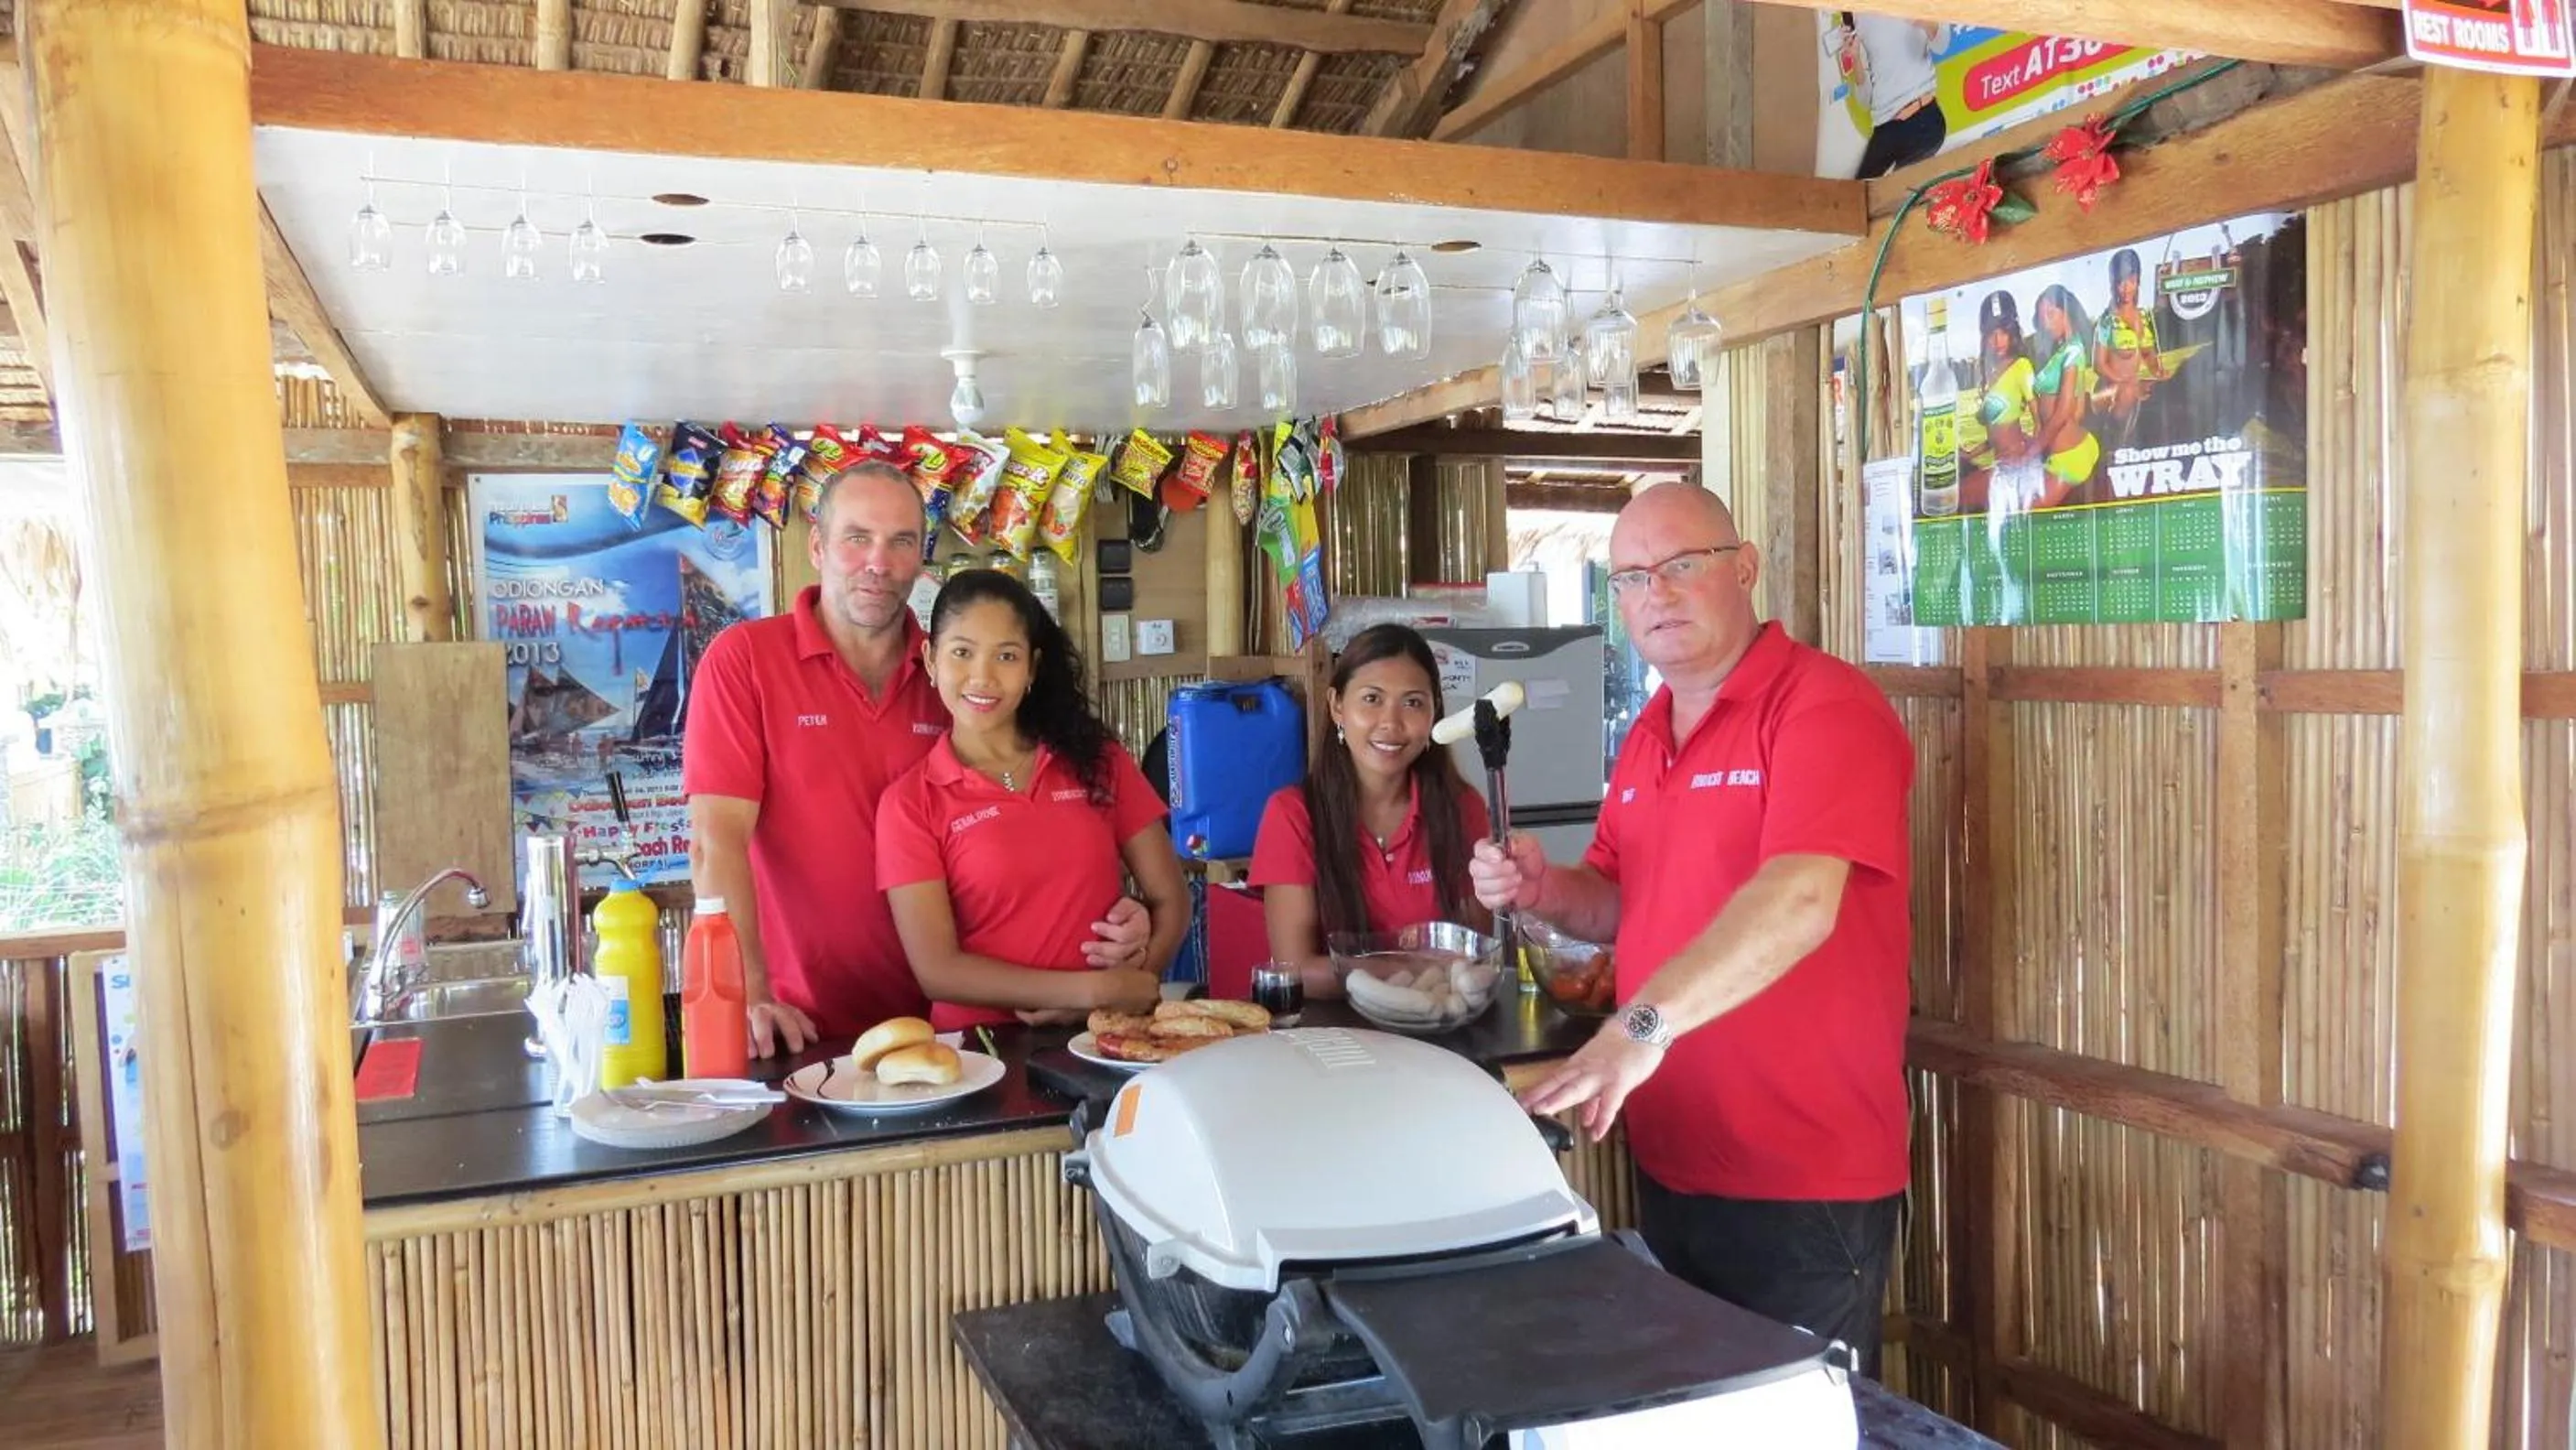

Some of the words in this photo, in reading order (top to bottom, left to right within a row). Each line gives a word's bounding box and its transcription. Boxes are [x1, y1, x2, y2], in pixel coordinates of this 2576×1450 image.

[2412, 10, 2450, 45] REST
[2452, 16, 2509, 53] ROOMS
[1980, 65, 2021, 100] Text
[2114, 446, 2170, 464] Show
[2172, 441, 2202, 457] me
[2204, 435, 2243, 453] the
[2107, 451, 2253, 498] WRAY
[492, 579, 605, 599] ODIONGAN
[582, 824, 638, 839] Hapy
